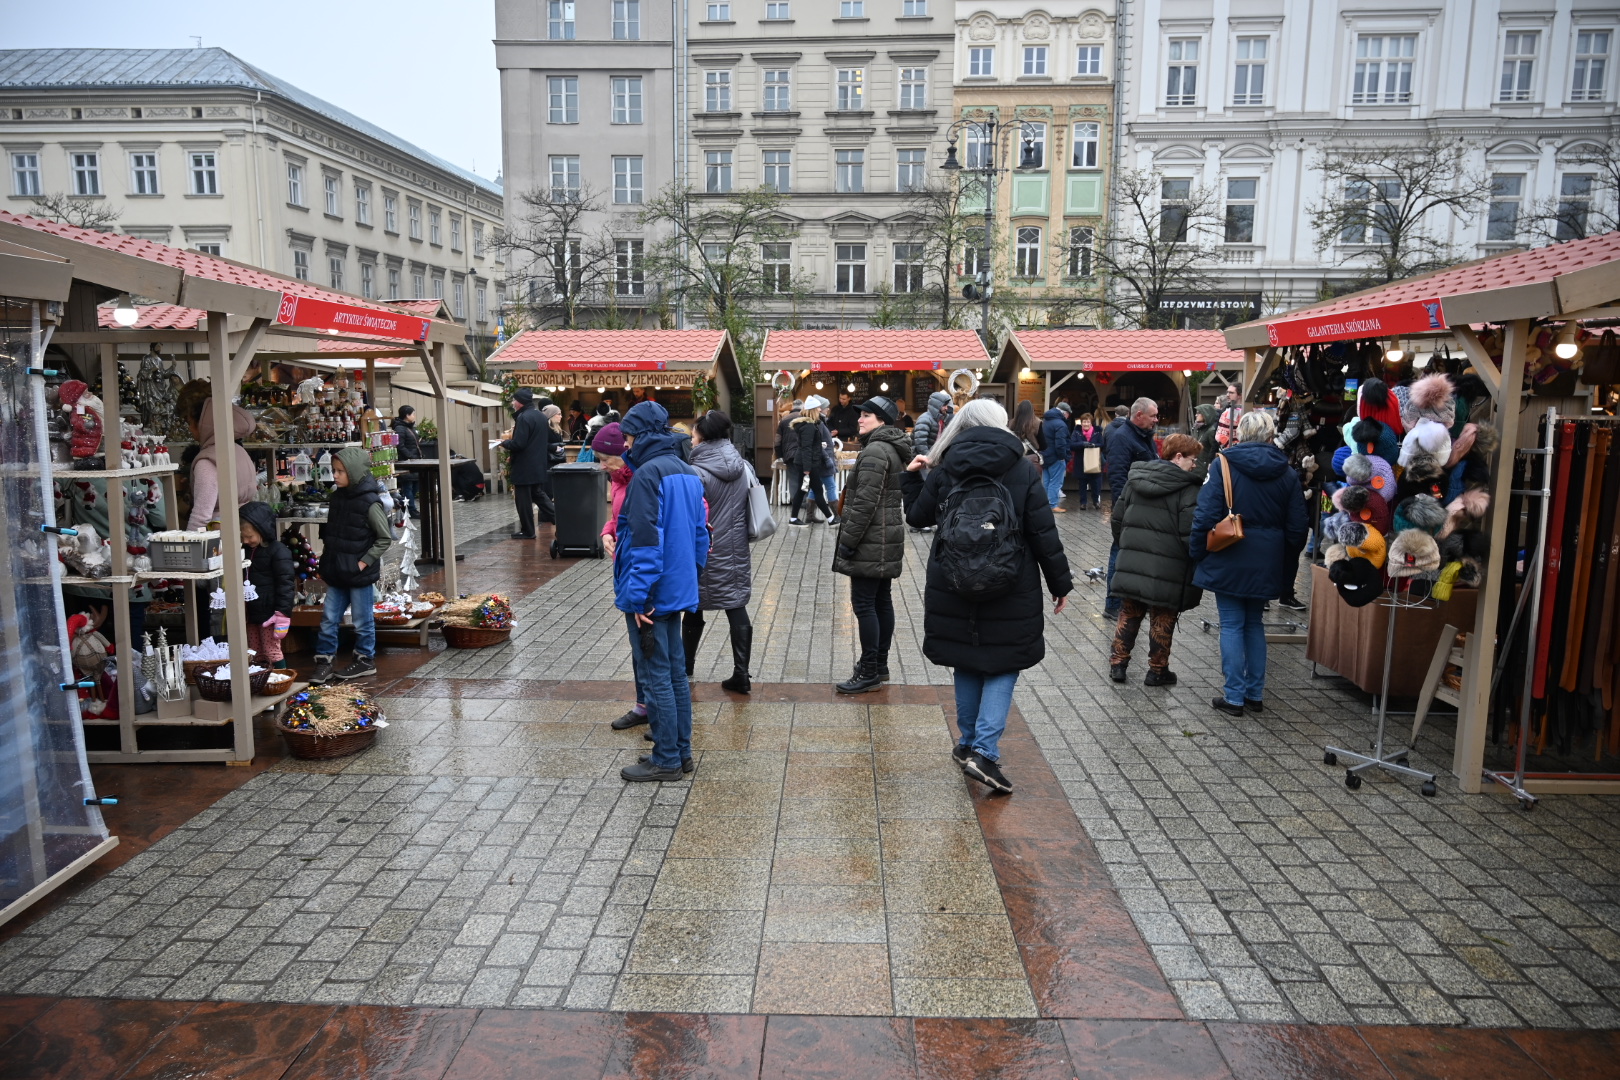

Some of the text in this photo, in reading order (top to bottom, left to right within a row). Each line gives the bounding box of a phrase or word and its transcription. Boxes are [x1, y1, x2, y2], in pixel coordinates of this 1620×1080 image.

[281, 301, 293, 317] 30
[333, 312, 398, 331] ARTYKUŁY ŚWIĄTECZNE
[1307, 318, 1382, 338] GALANTERIA SKÓRZANA
[1269, 328, 1278, 341] 43
[515, 374, 696, 386] REGIONALNE PLACKI ZIEMNIACZANE
